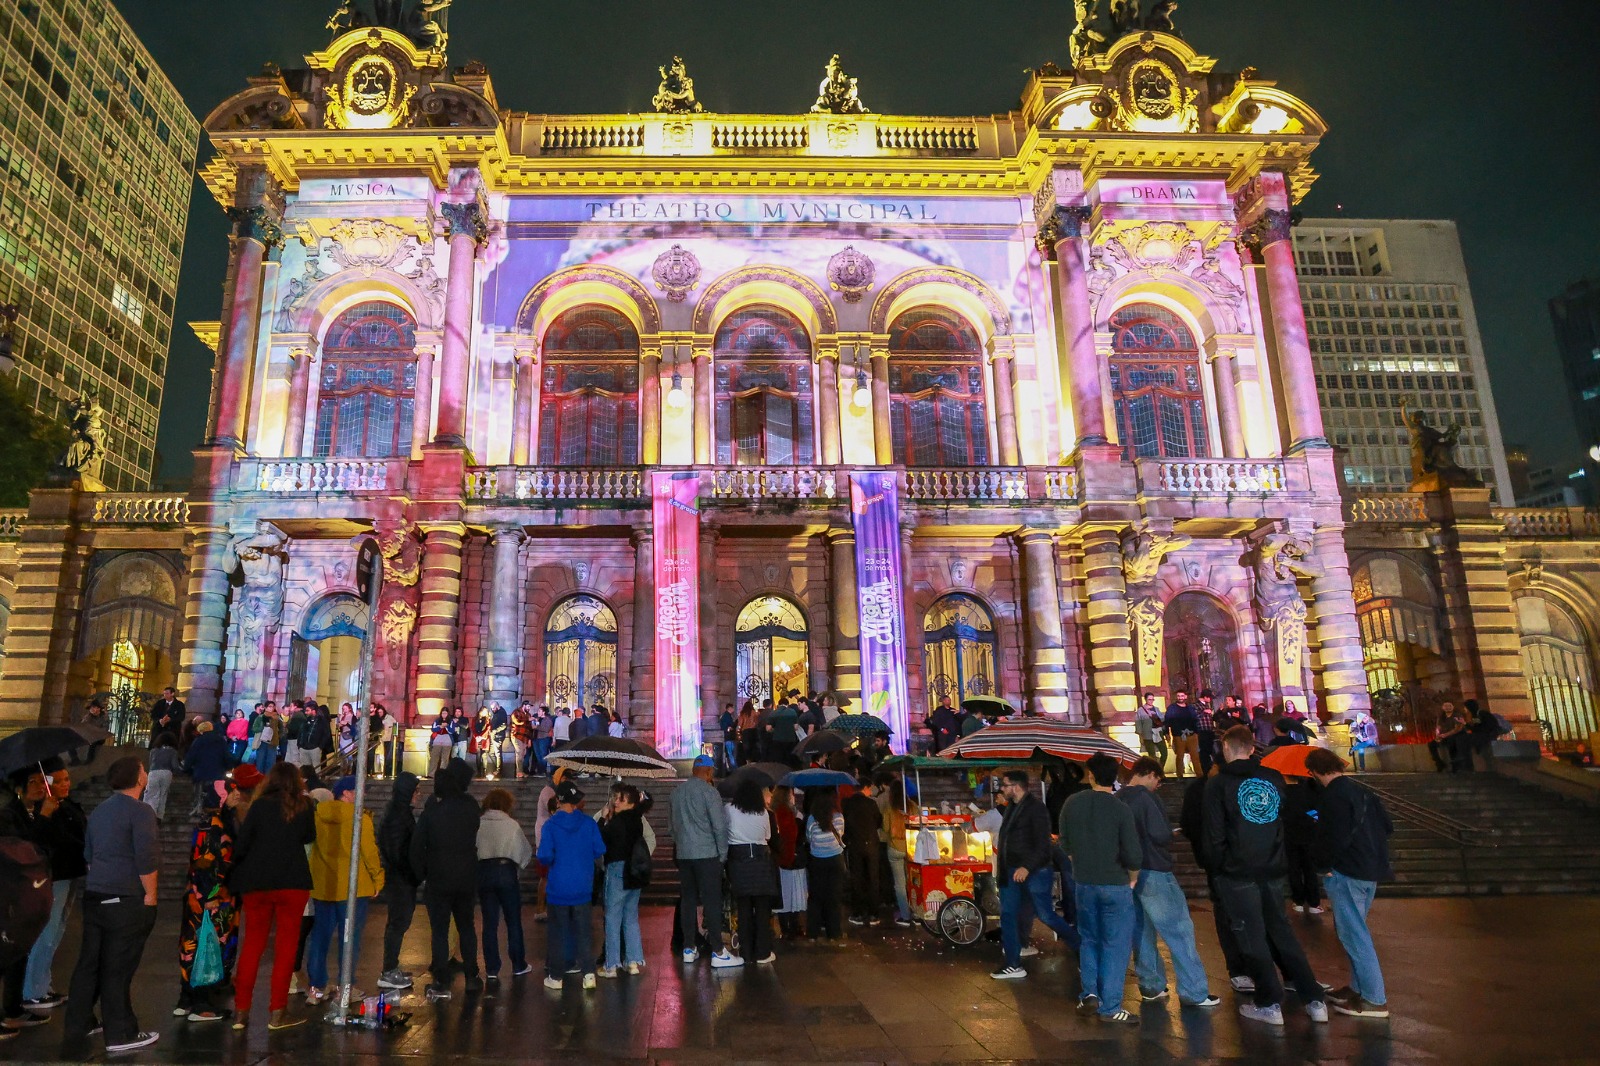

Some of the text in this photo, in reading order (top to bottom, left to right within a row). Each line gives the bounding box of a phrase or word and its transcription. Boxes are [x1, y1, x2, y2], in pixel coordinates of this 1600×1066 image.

[330, 183, 396, 196] MVSICA
[1131, 186, 1196, 199] DRAMA
[585, 202, 937, 220] THEATRO MVNICIPAL
[672, 577, 691, 646] CULTURAL
[873, 576, 894, 645] CULTURAL
